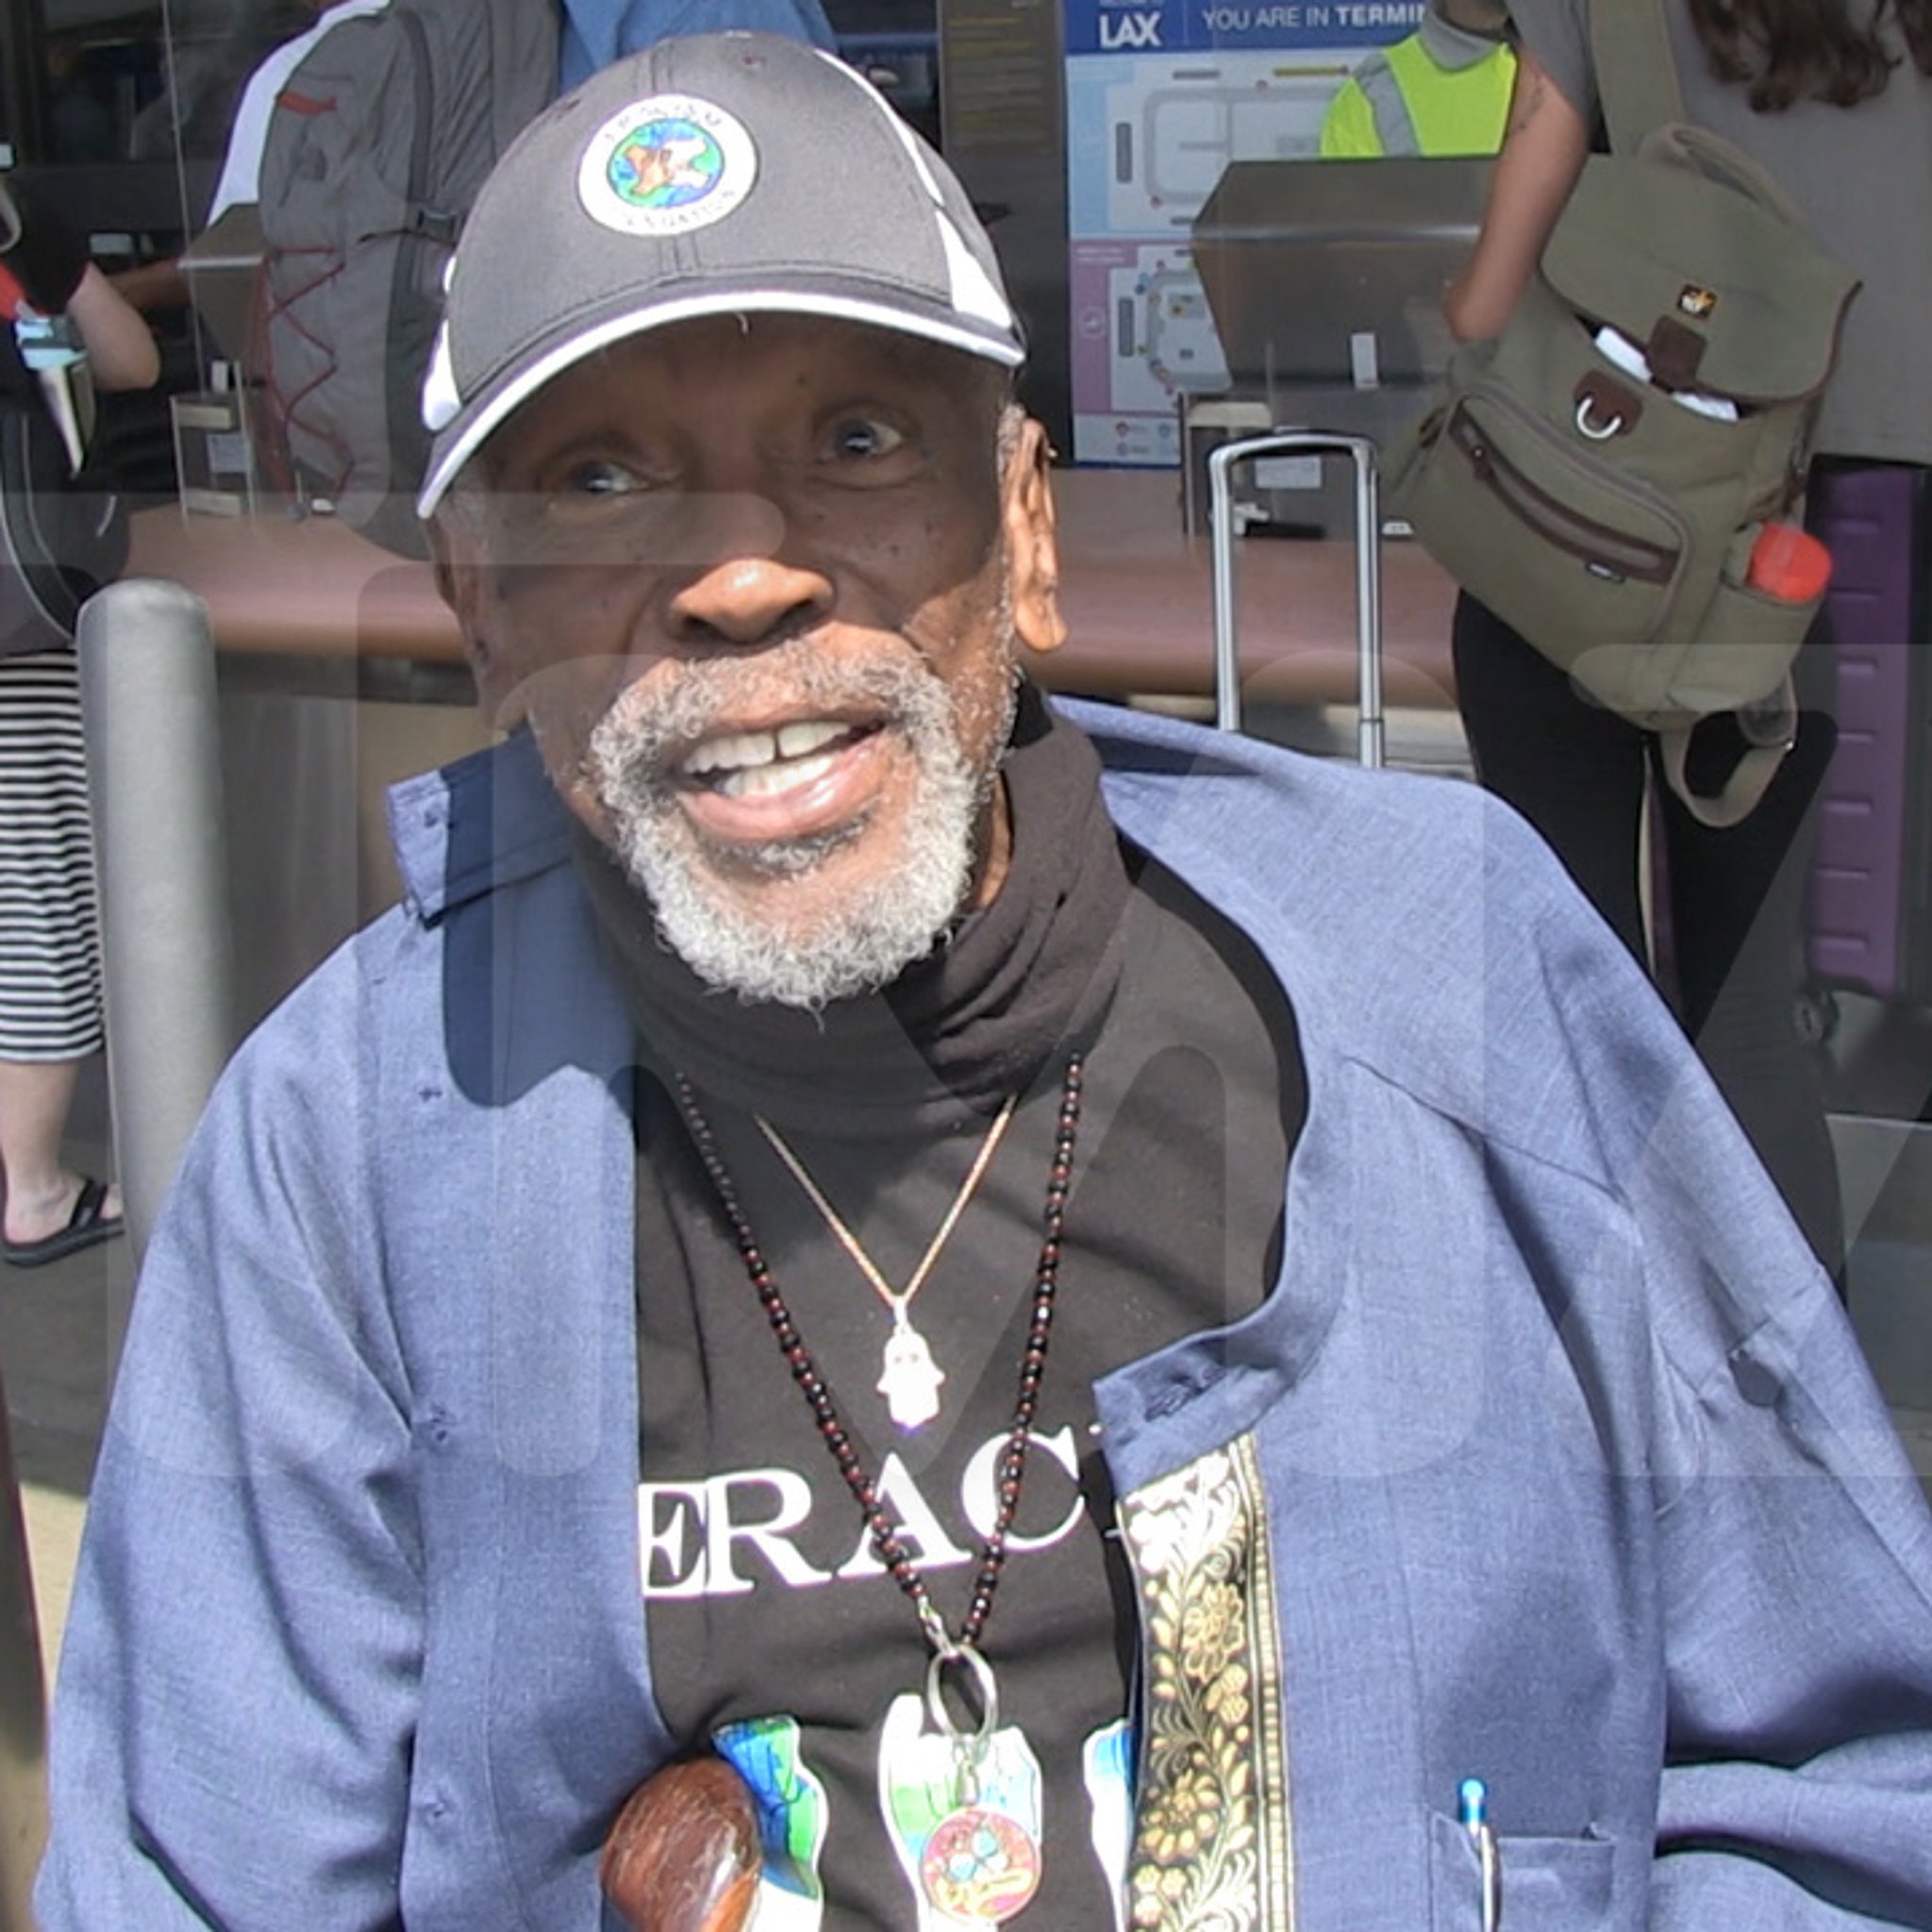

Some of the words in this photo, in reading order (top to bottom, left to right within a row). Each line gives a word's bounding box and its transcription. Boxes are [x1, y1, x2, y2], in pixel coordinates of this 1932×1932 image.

[1099, 11, 1161, 48] LAX
[1203, 8, 1250, 30] YOU
[1256, 8, 1301, 27] ARE
[1307, 8, 1330, 26] IN
[638, 1425, 1119, 1596] ERAC
